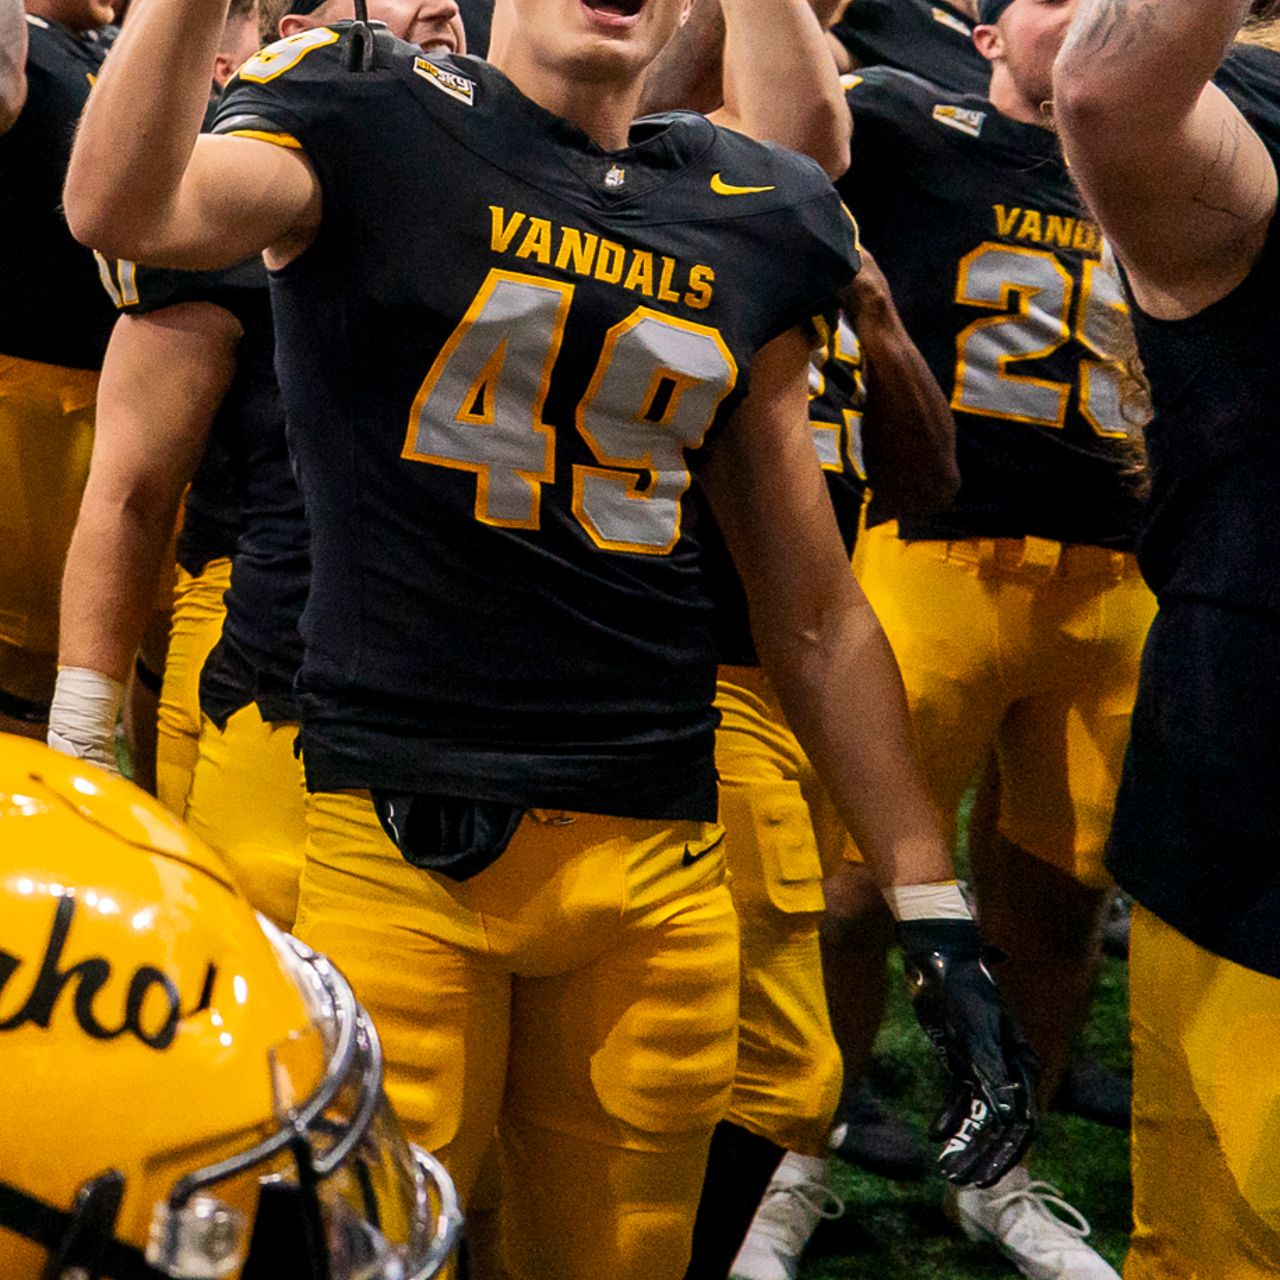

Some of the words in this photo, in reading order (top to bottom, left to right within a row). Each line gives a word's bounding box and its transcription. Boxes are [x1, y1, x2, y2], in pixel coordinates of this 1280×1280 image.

[488, 205, 716, 310] VANDALS
[993, 204, 1103, 251] VAND
[400, 268, 739, 555] 49
